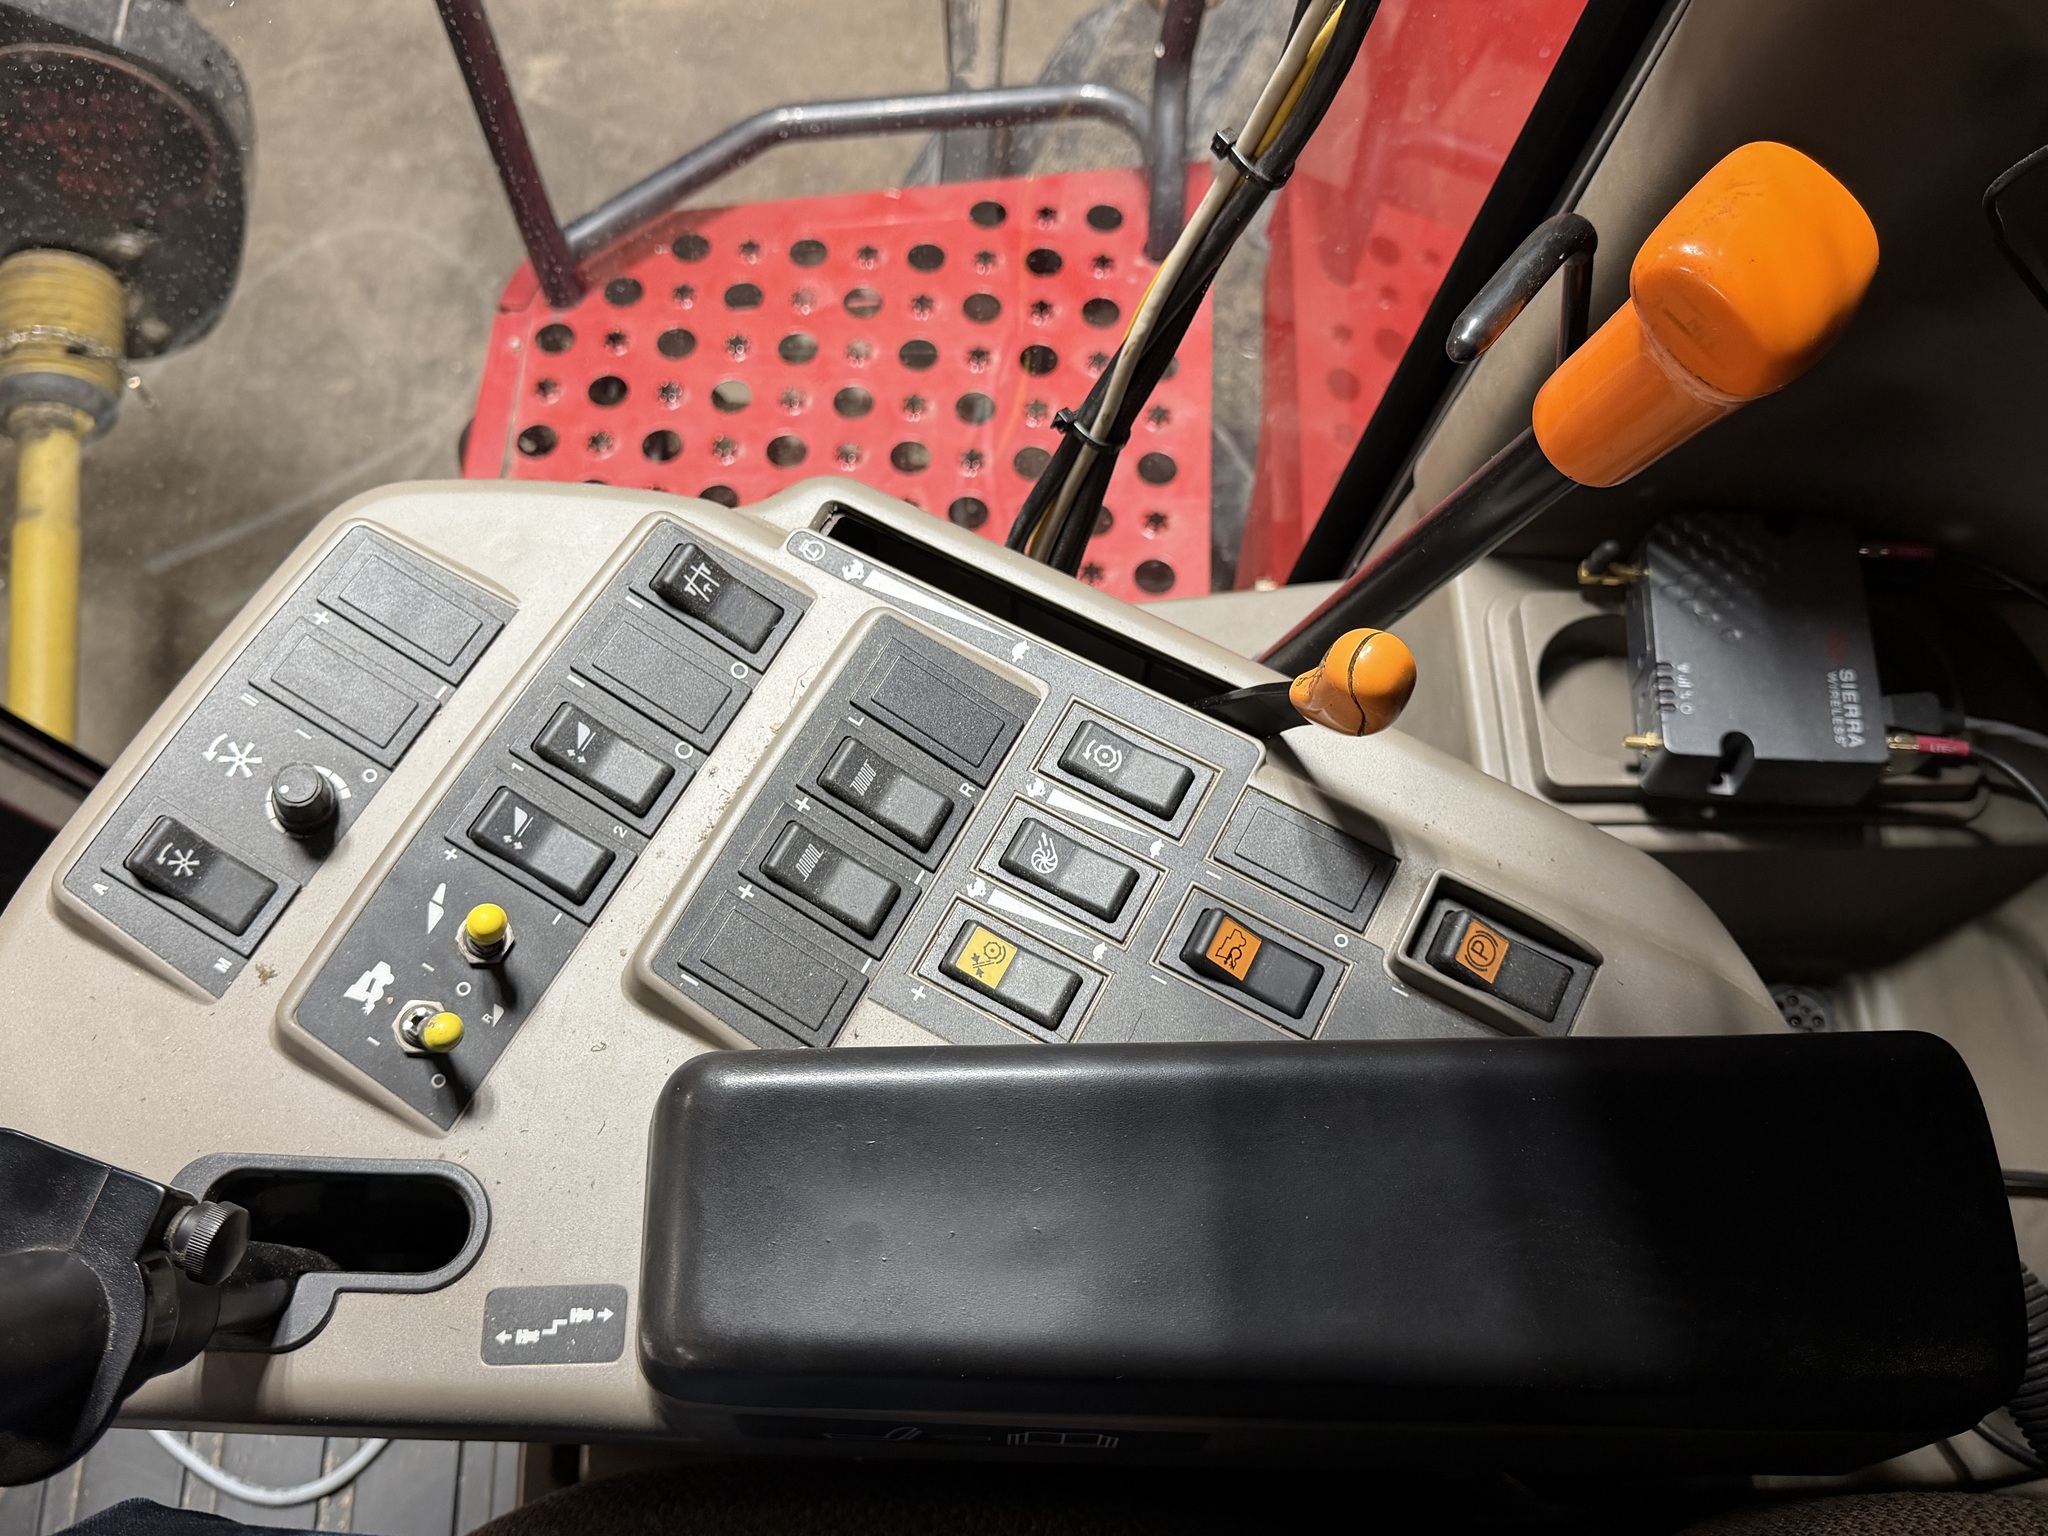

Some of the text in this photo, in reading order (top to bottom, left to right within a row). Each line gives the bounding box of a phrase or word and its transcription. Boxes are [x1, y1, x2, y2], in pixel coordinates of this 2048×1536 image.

[1839, 668, 1866, 748] SIERRA
[848, 714, 864, 727] L
[959, 783, 976, 798] R
[612, 826, 628, 839] 2
[92, 882, 109, 896] A
[1471, 940, 1488, 961] P
[213, 957, 233, 973] M
[481, 1013, 493, 1024] R
